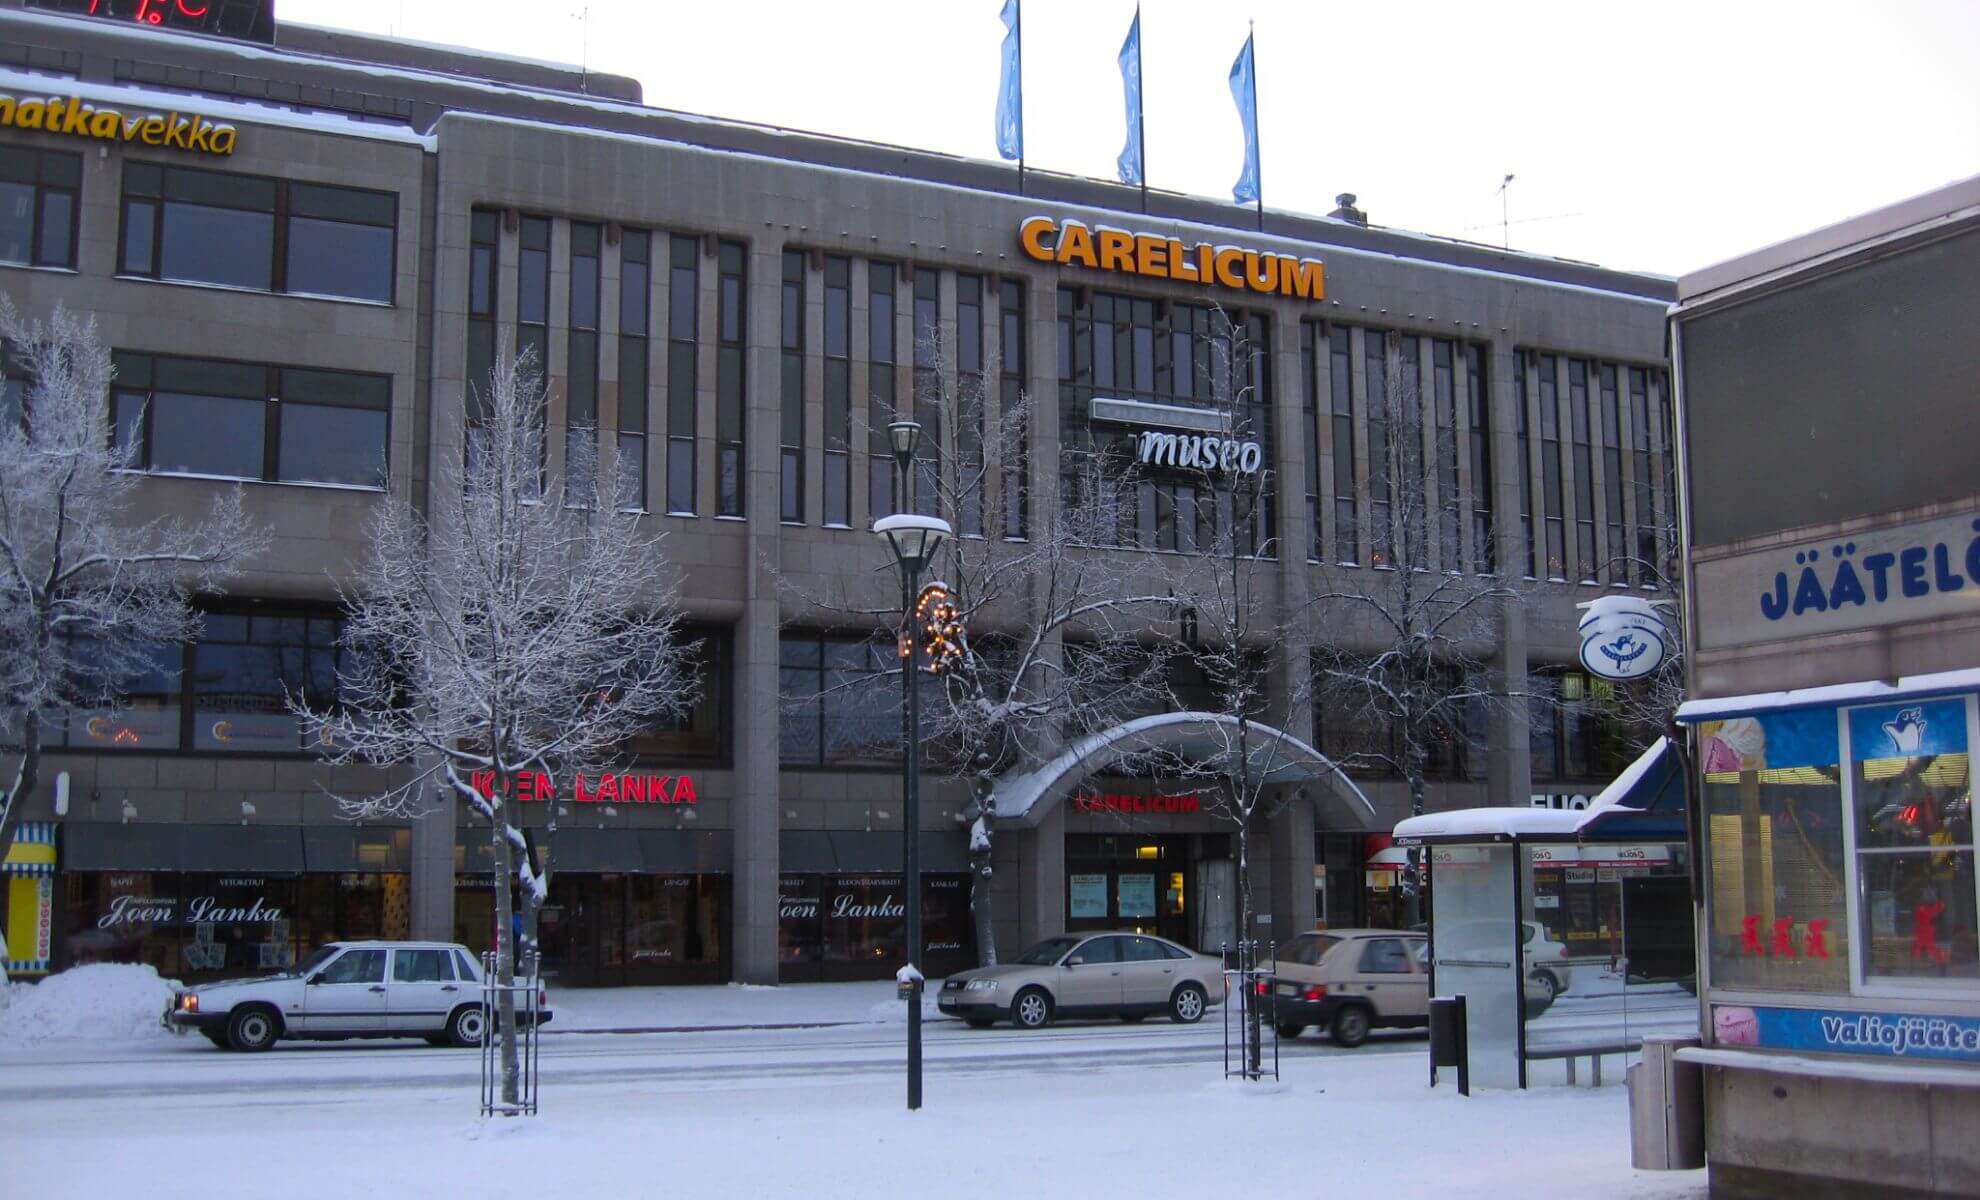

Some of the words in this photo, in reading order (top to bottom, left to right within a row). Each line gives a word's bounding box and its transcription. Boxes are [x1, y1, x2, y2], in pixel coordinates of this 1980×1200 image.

[1019, 215, 1326, 300] CARELICUM
[1138, 431, 1261, 473] museo
[471, 770, 556, 801] JOEN
[576, 770, 698, 804] LANKA
[1531, 794, 1599, 810] ELIO
[1567, 869, 1594, 881] Studio
[98, 896, 173, 929] Joen
[186, 897, 281, 923] Lanka
[832, 894, 905, 918] Lanka
[1822, 1016, 1980, 1054] Valiojääte
